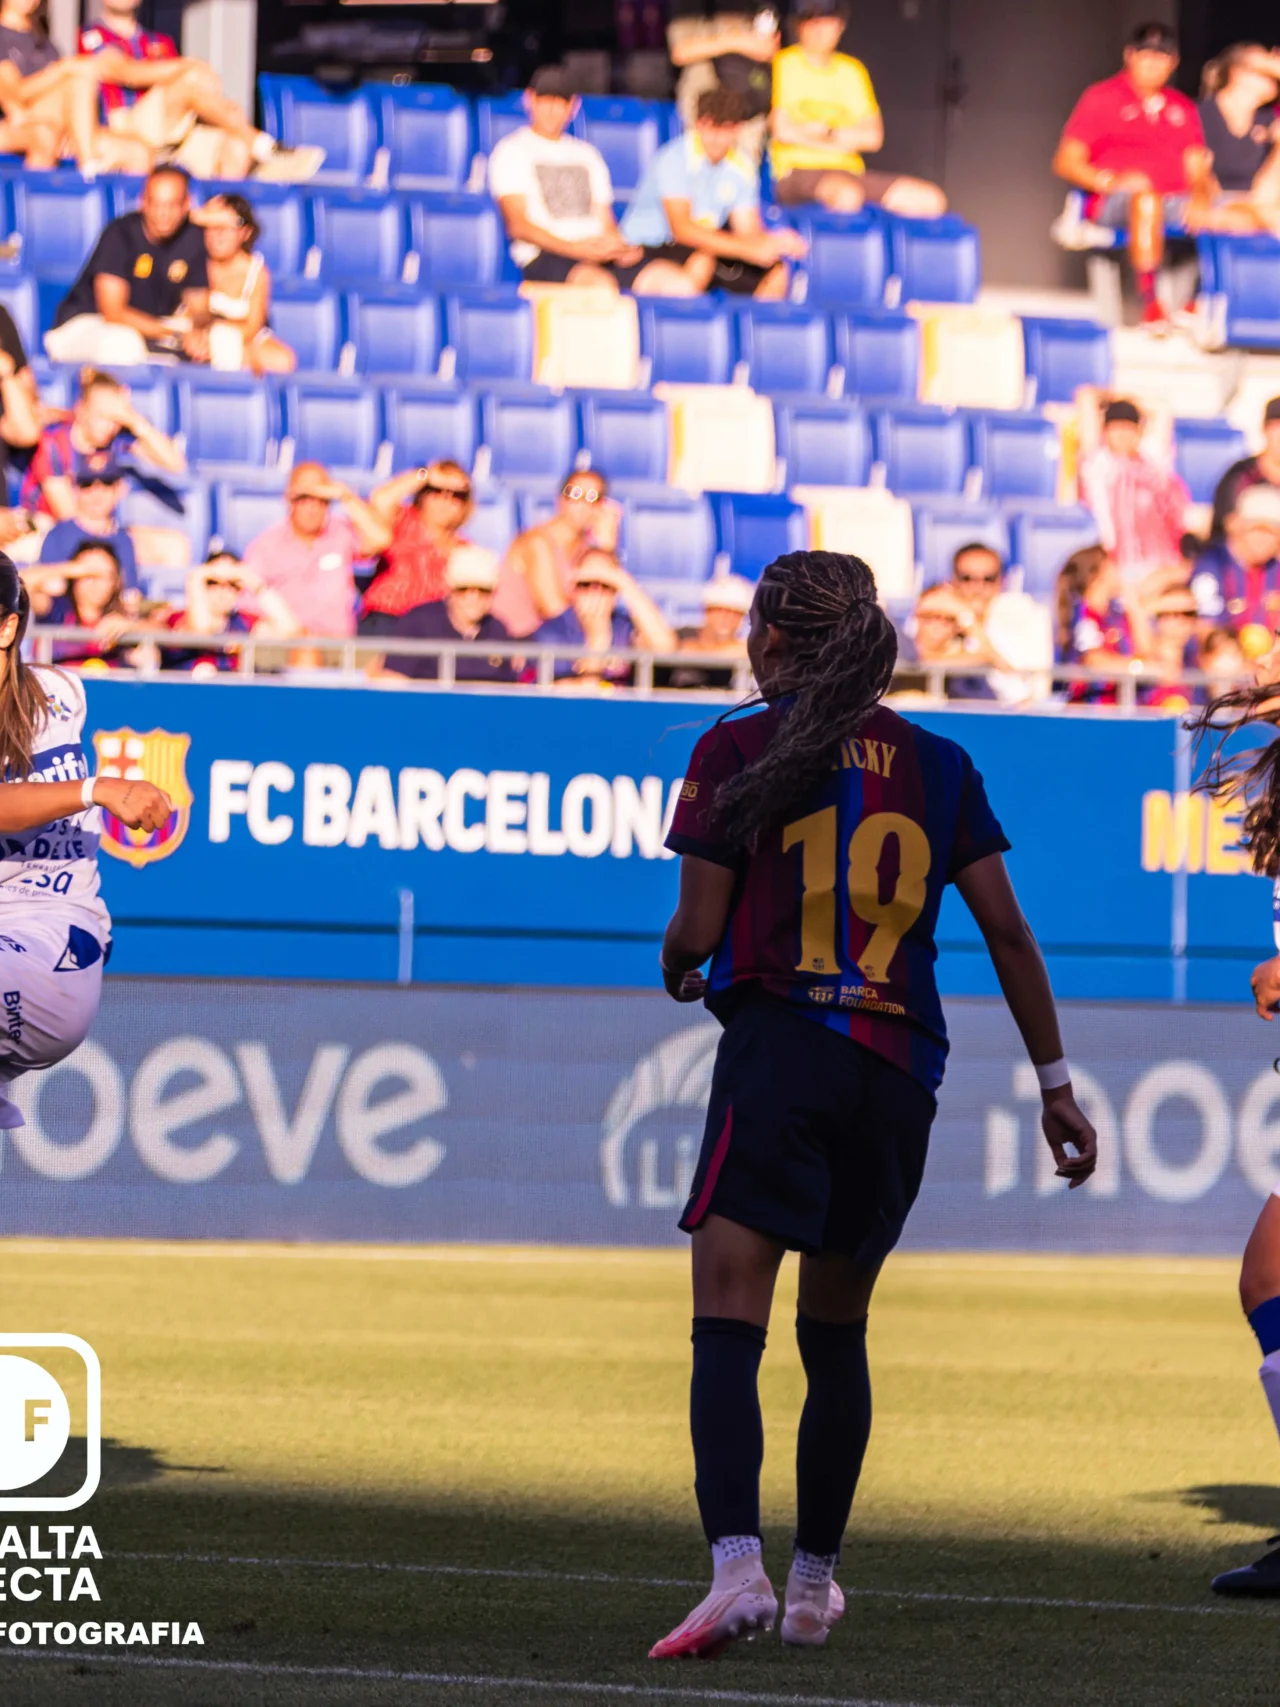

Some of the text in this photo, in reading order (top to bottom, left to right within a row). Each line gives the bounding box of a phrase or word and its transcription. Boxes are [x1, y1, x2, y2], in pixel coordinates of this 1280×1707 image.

[831, 737, 897, 779] ICKY
[209, 759, 295, 845] FC
[782, 805, 932, 984] 19
[839, 995, 905, 1015] FOUNDATION
[840, 985, 878, 999] BARÇA
